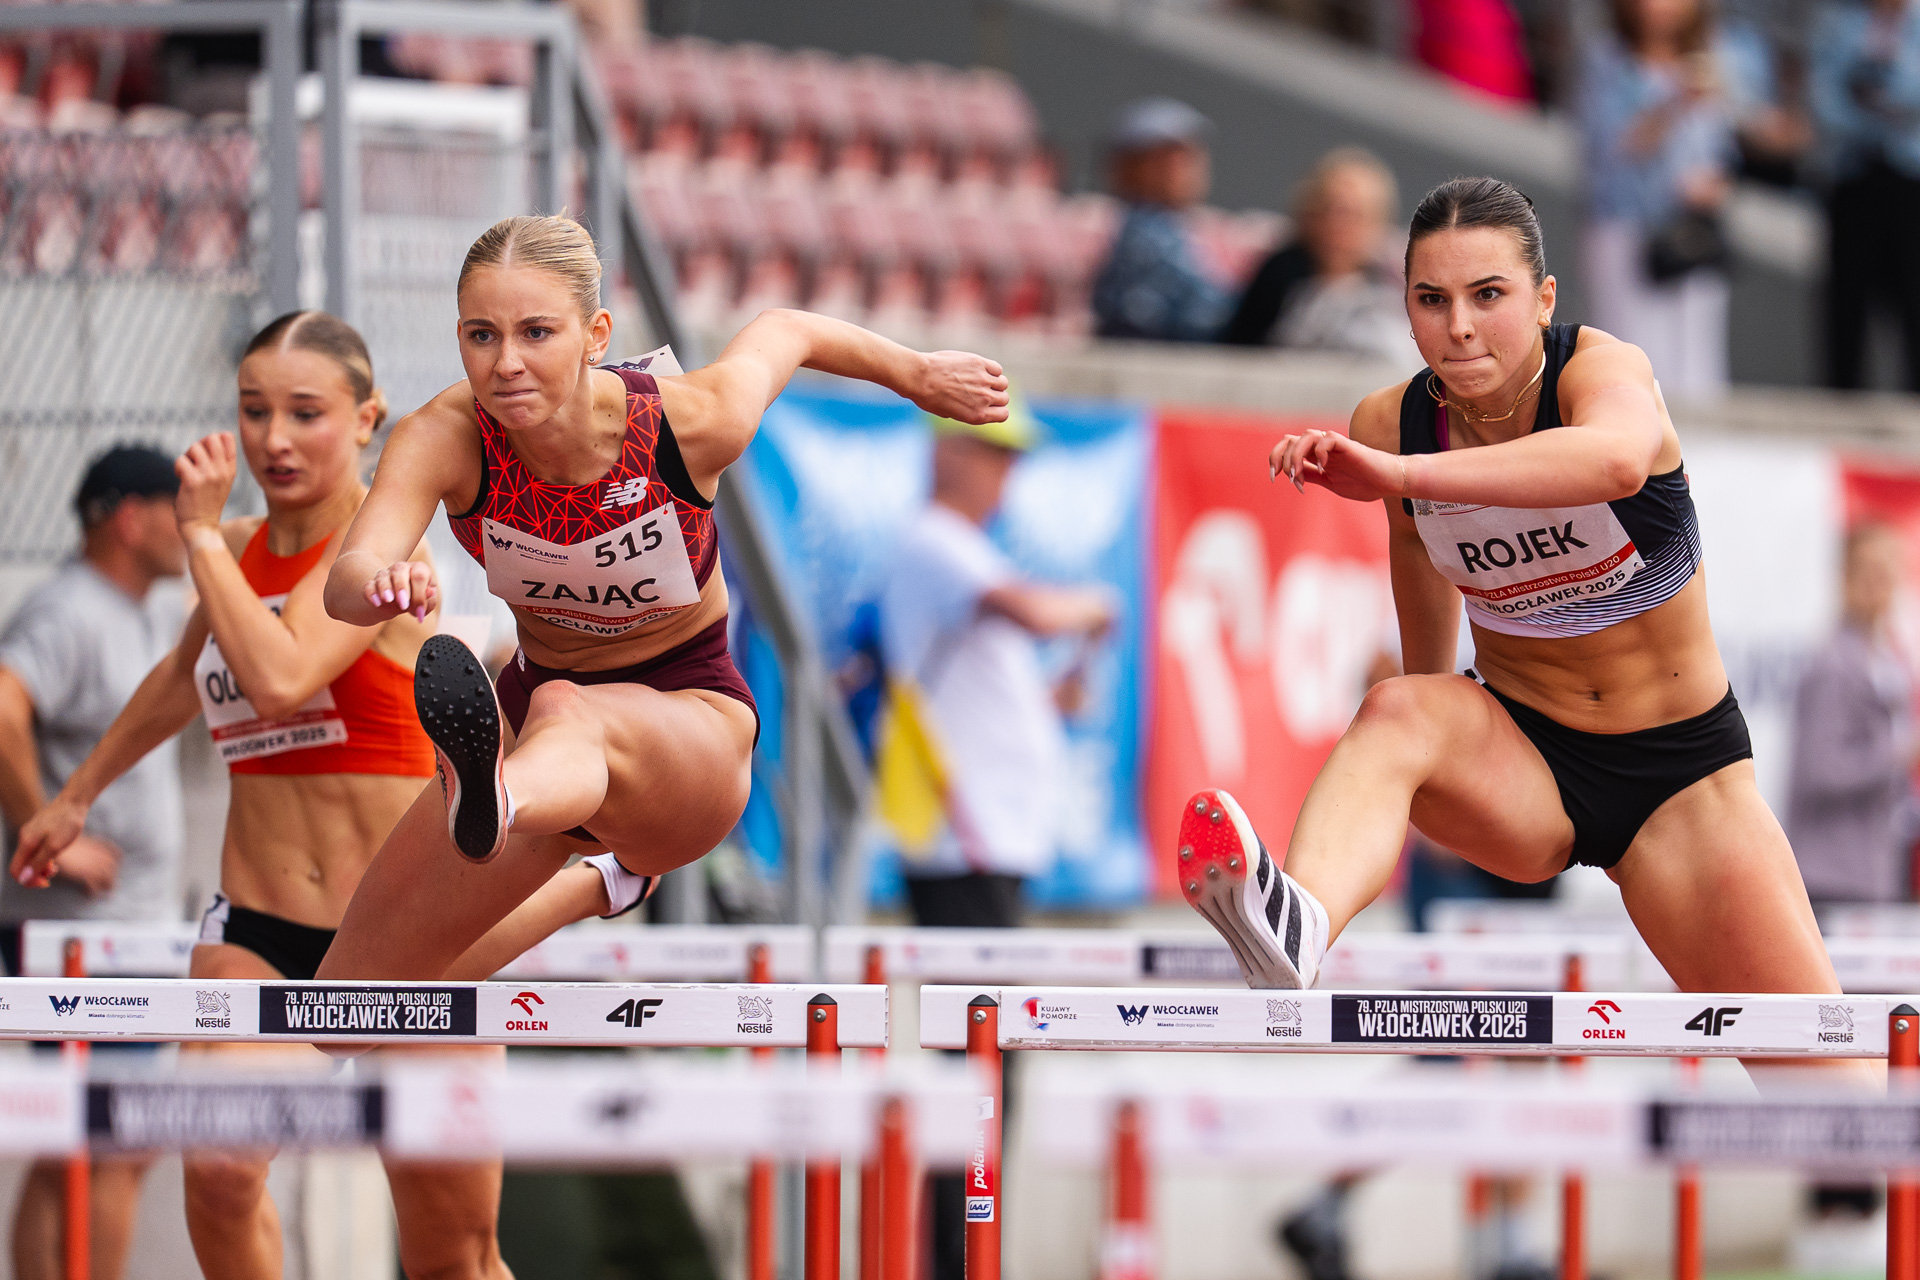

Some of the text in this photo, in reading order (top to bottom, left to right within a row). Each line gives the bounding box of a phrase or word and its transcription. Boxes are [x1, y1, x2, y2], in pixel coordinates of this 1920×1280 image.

[515, 542, 569, 560] WŁOCŁAWEK
[595, 519, 663, 568] 515
[1456, 520, 1589, 574] ROJEK
[1507, 576, 1569, 596] Mistrzostwa
[1569, 567, 1599, 581] Polski
[1600, 555, 1620, 570] U20
[521, 578, 661, 609] ZAJĄC
[1482, 570, 1626, 614] WŁOCŁAWEK 2025
[539, 611, 677, 635] OCŁAWEK 202
[560, 608, 625, 625] Mistrzostwa
[84, 996, 149, 1007] WŁOCŁAWEK
[284, 992, 452, 1006] 79. PZLA MISTRZOSTWA POLSKI U20
[1152, 1005, 1219, 1015] WŁOCŁAWEK
[1357, 1000, 1528, 1014] 79. PZLA MISTRZOSTWA POLSKI U20
[285, 1005, 451, 1030] WŁOCŁAWEK 2025
[605, 998, 663, 1028] 4F
[1684, 1007, 1743, 1036] 4F
[505, 1020, 548, 1031] ORLEN
[1357, 1013, 1527, 1038] WŁOCŁAWEK 2025
[1583, 1029, 1625, 1039] ORLEN
[970, 1203, 990, 1211] IAAF
